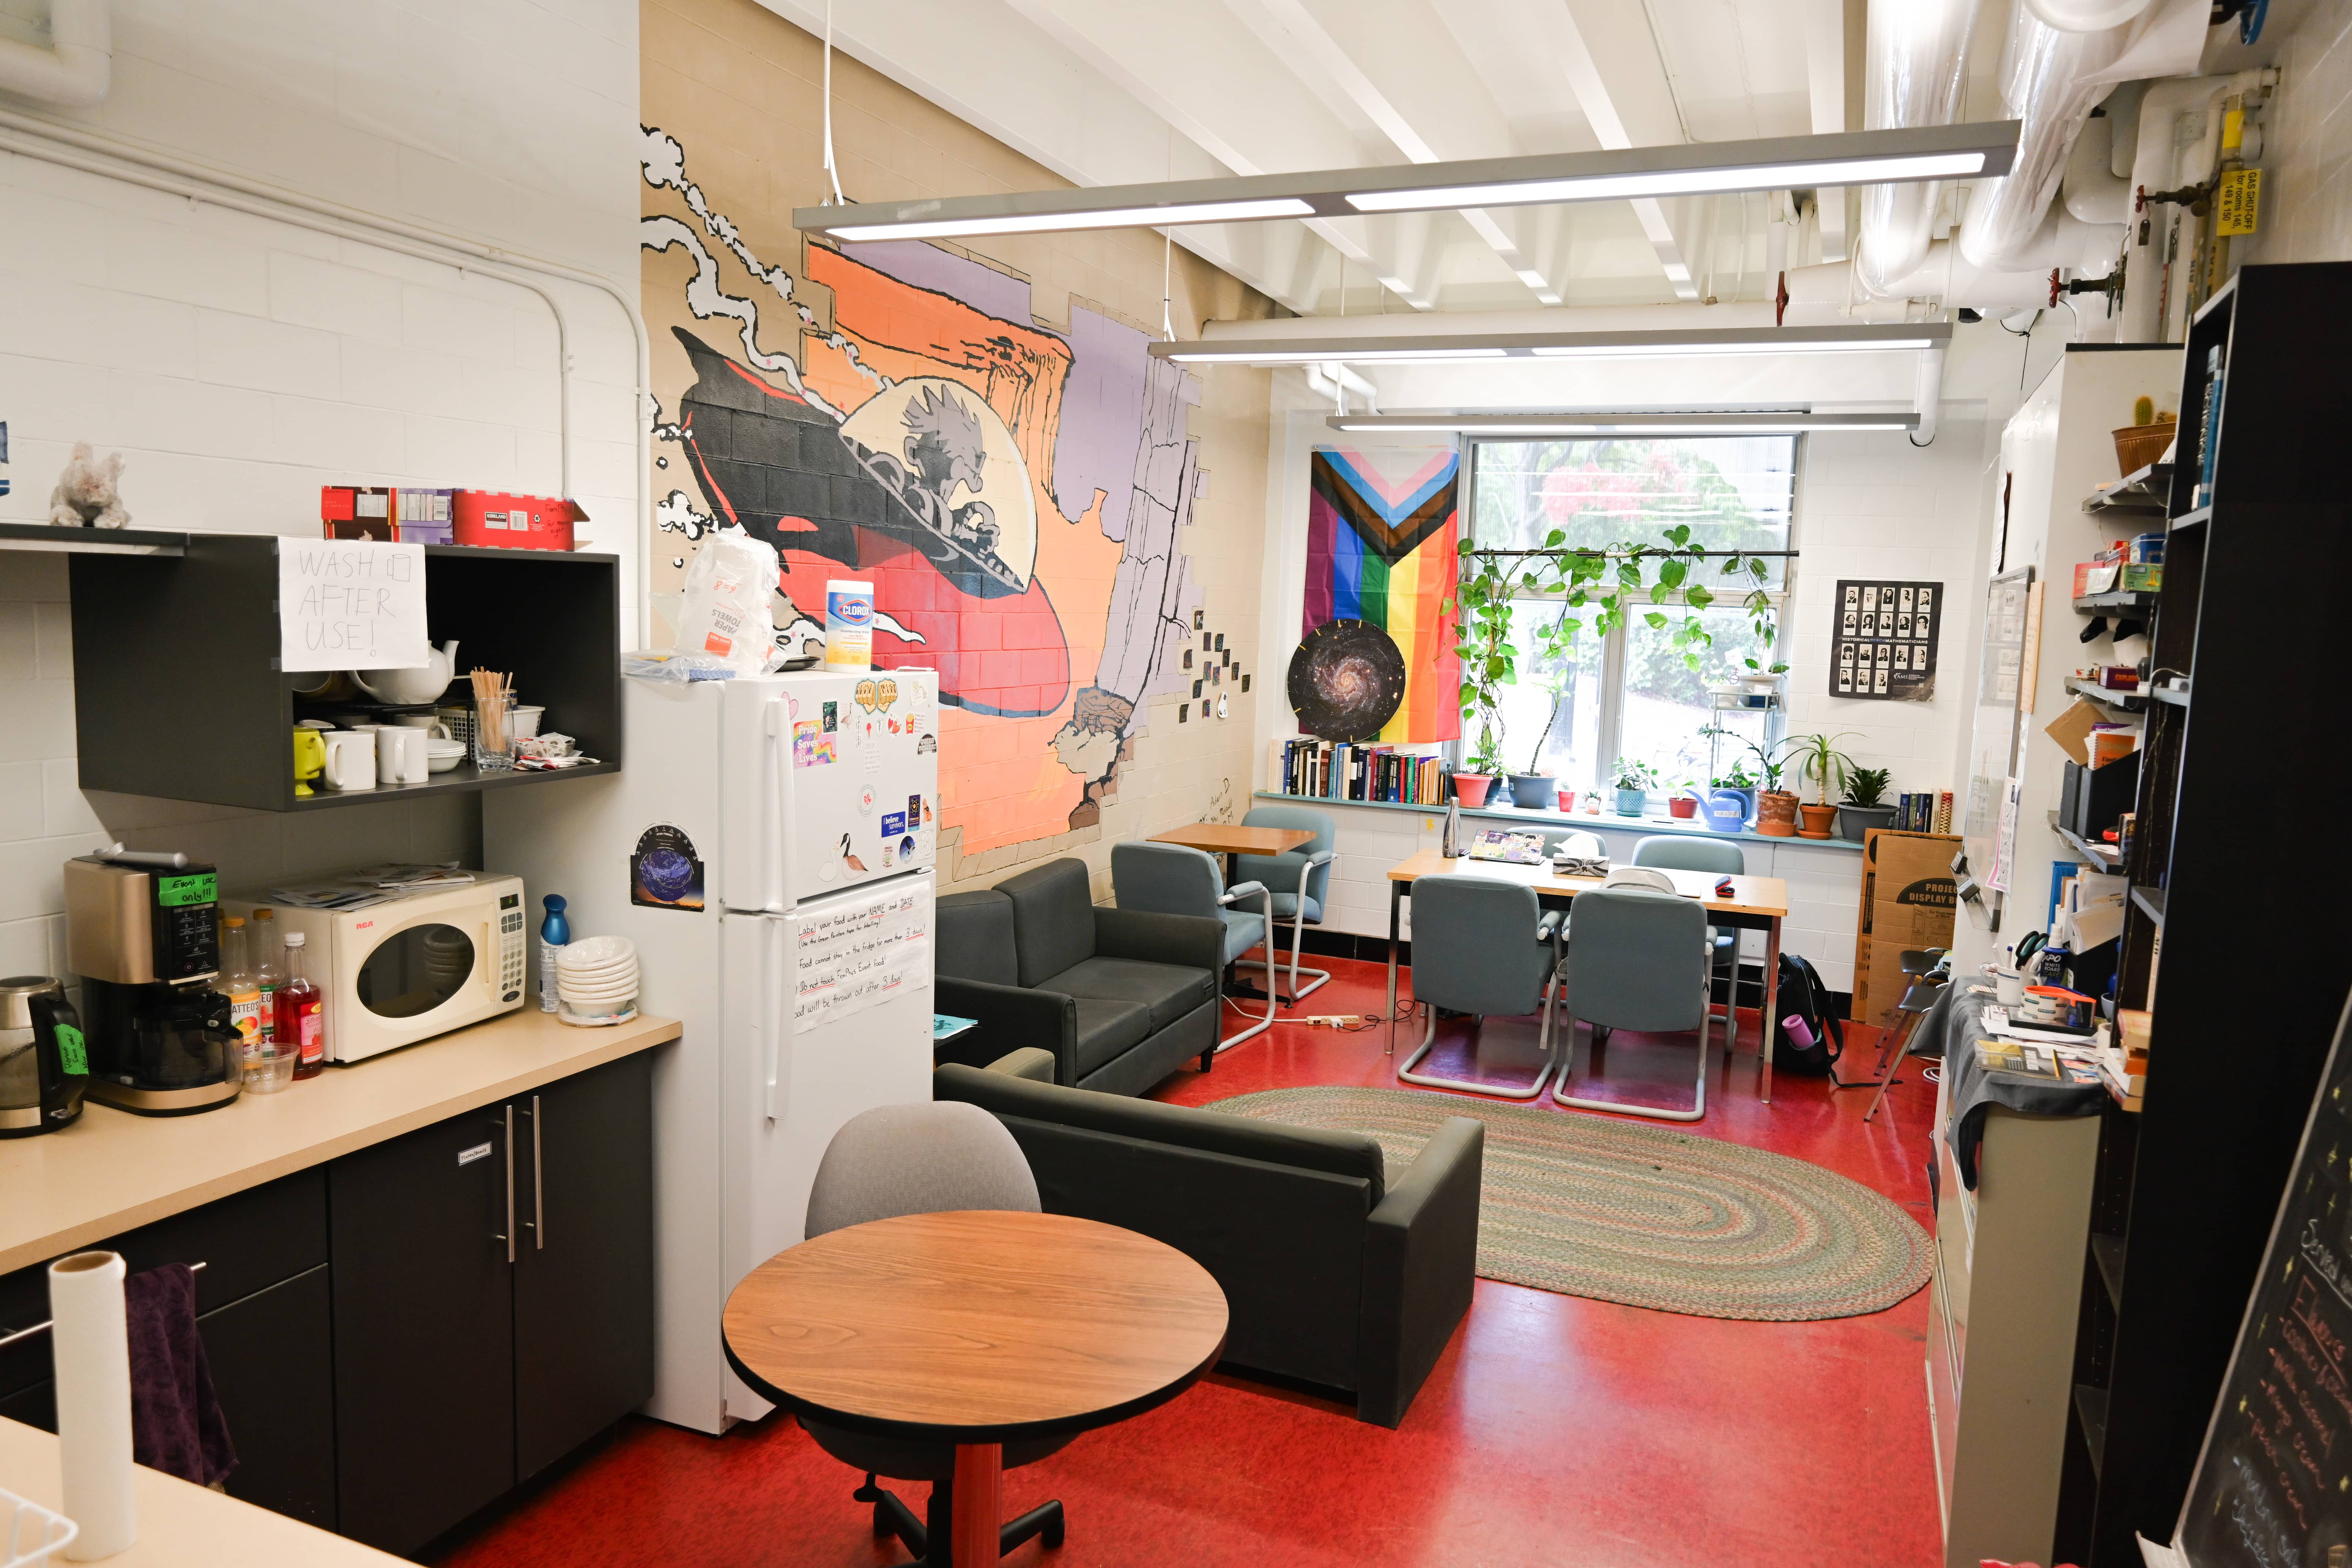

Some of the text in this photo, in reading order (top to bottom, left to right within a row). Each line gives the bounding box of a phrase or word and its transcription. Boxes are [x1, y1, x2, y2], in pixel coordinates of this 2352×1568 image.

[2225, 185, 2233, 198] 149
[2234, 188, 2243, 211] rooms
[2244, 172, 2257, 229] GAS SHUT-OFF
[2222, 209, 2231, 221] 150
[2231, 214, 2241, 229] 145,
[300, 549, 374, 577] WASH
[299, 584, 396, 617] AFTER
[843, 605, 869, 616] CLOROX
[711, 609, 741, 628] TOWELS
[714, 619, 737, 634] PAPER
[306, 620, 377, 657] USE!
[798, 724, 817, 735] Pride
[798, 739, 818, 749] Saves
[798, 753, 818, 763] Lives
[1210, 792, 1223, 809] Adam
[1223, 778, 1230, 794] D.
[885, 816, 899, 824] believe
[889, 821, 904, 830] survivors.
[643, 822, 656, 831] SEPTEMBER
[677, 825, 690, 835] NOVEMBER
[172, 879, 196, 888] Event
[1926, 884, 1957, 893] PROJEC
[182, 888, 211, 902] only!!!
[1909, 893, 1946, 903] DISPLAY
[798, 923, 816, 936] Label
[820, 922, 831, 931] your
[834, 915, 845, 925] food
[847, 913, 857, 923] with
[869, 903, 885, 916] NAME
[888, 901, 897, 911] and
[900, 897, 914, 908] DATE
[356, 921, 373, 929] RCA
[798, 939, 808, 949] (Use
[831, 931, 845, 939] Painters
[864, 917, 881, 929] labelling)
[799, 957, 812, 969] Food
[815, 953, 831, 965] cannot
[833, 952, 843, 961] stay
[862, 941, 875, 951] fridge
[906, 927, 910, 937] 3
[913, 923, 925, 935] days!
[2041, 954, 2061, 963] XPO
[800, 955, 887, 993] Do not touch FemPhys Event food!
[794, 1005, 805, 1019] ood
[808, 999, 820, 1013] will
[823, 998, 830, 1008] be
[833, 992, 852, 1004] thrown
[866, 983, 879, 993] after
[882, 976, 888, 988] 3
[890, 971, 903, 983] days!
[232, 1001, 259, 1014] ATTEO'S
[461, 1148, 487, 1161] Plates/Bowls
